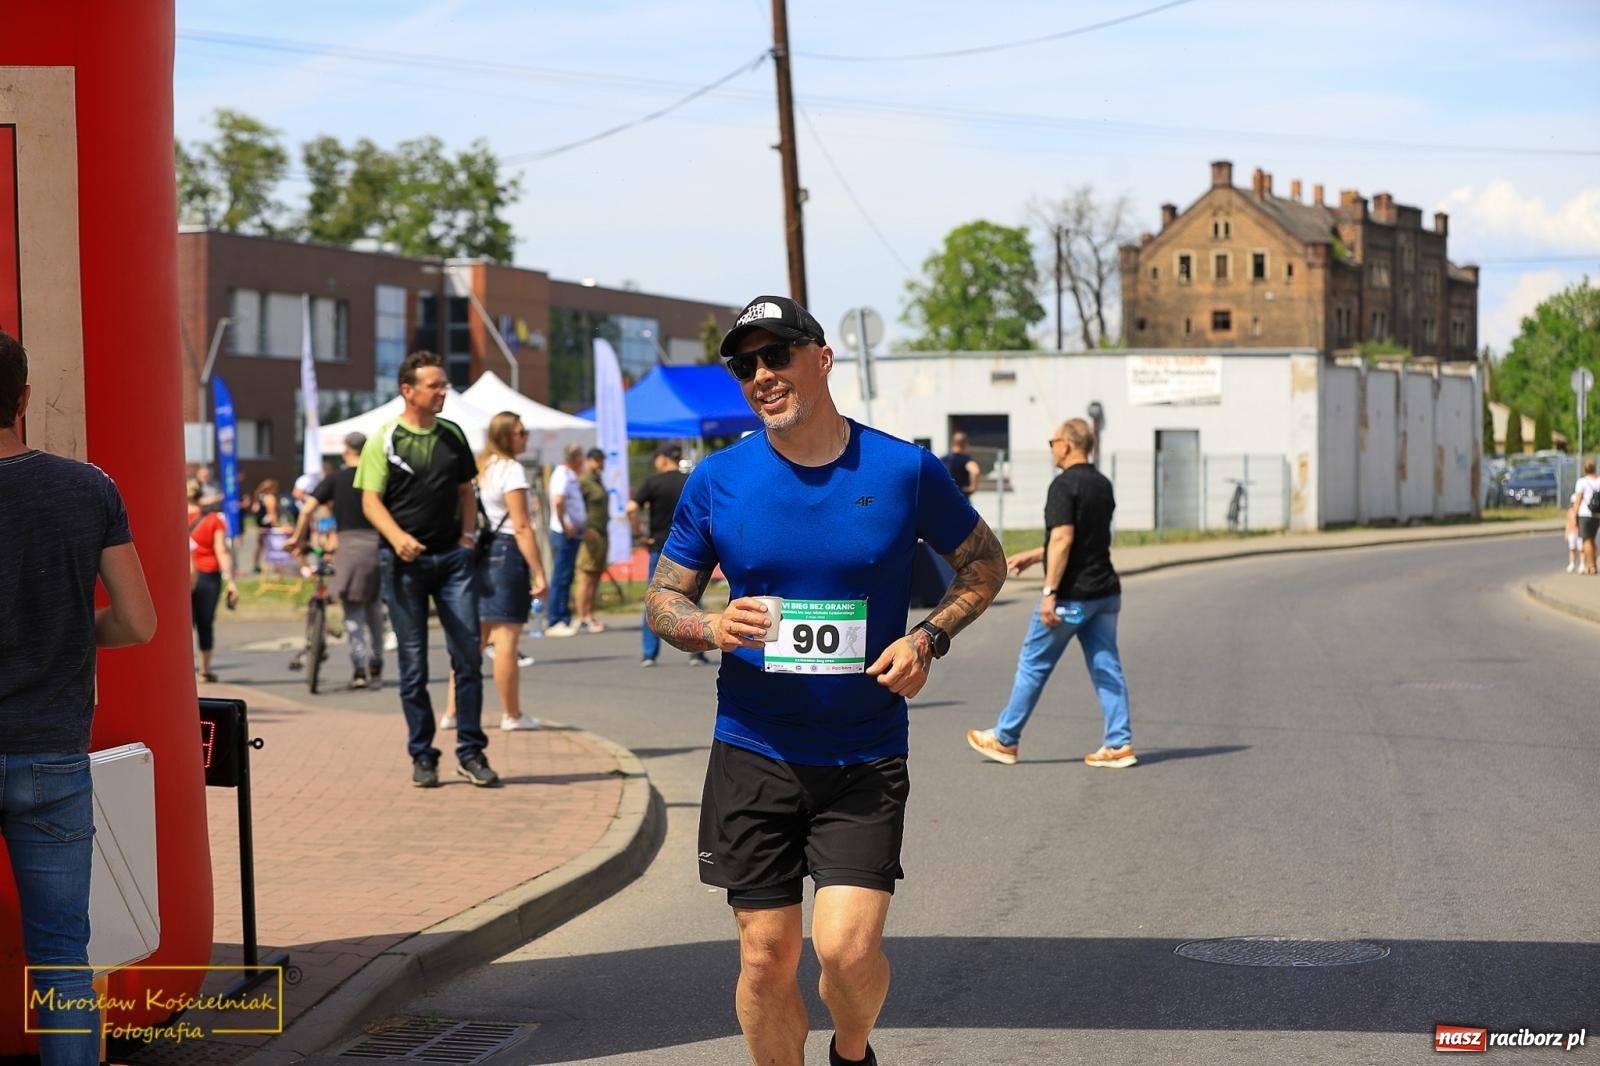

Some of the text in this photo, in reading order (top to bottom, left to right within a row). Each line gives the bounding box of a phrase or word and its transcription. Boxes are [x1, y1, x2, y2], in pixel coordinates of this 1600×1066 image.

[855, 496, 875, 506] 4F
[825, 603, 855, 611] GRANIC
[793, 624, 840, 654] 90
